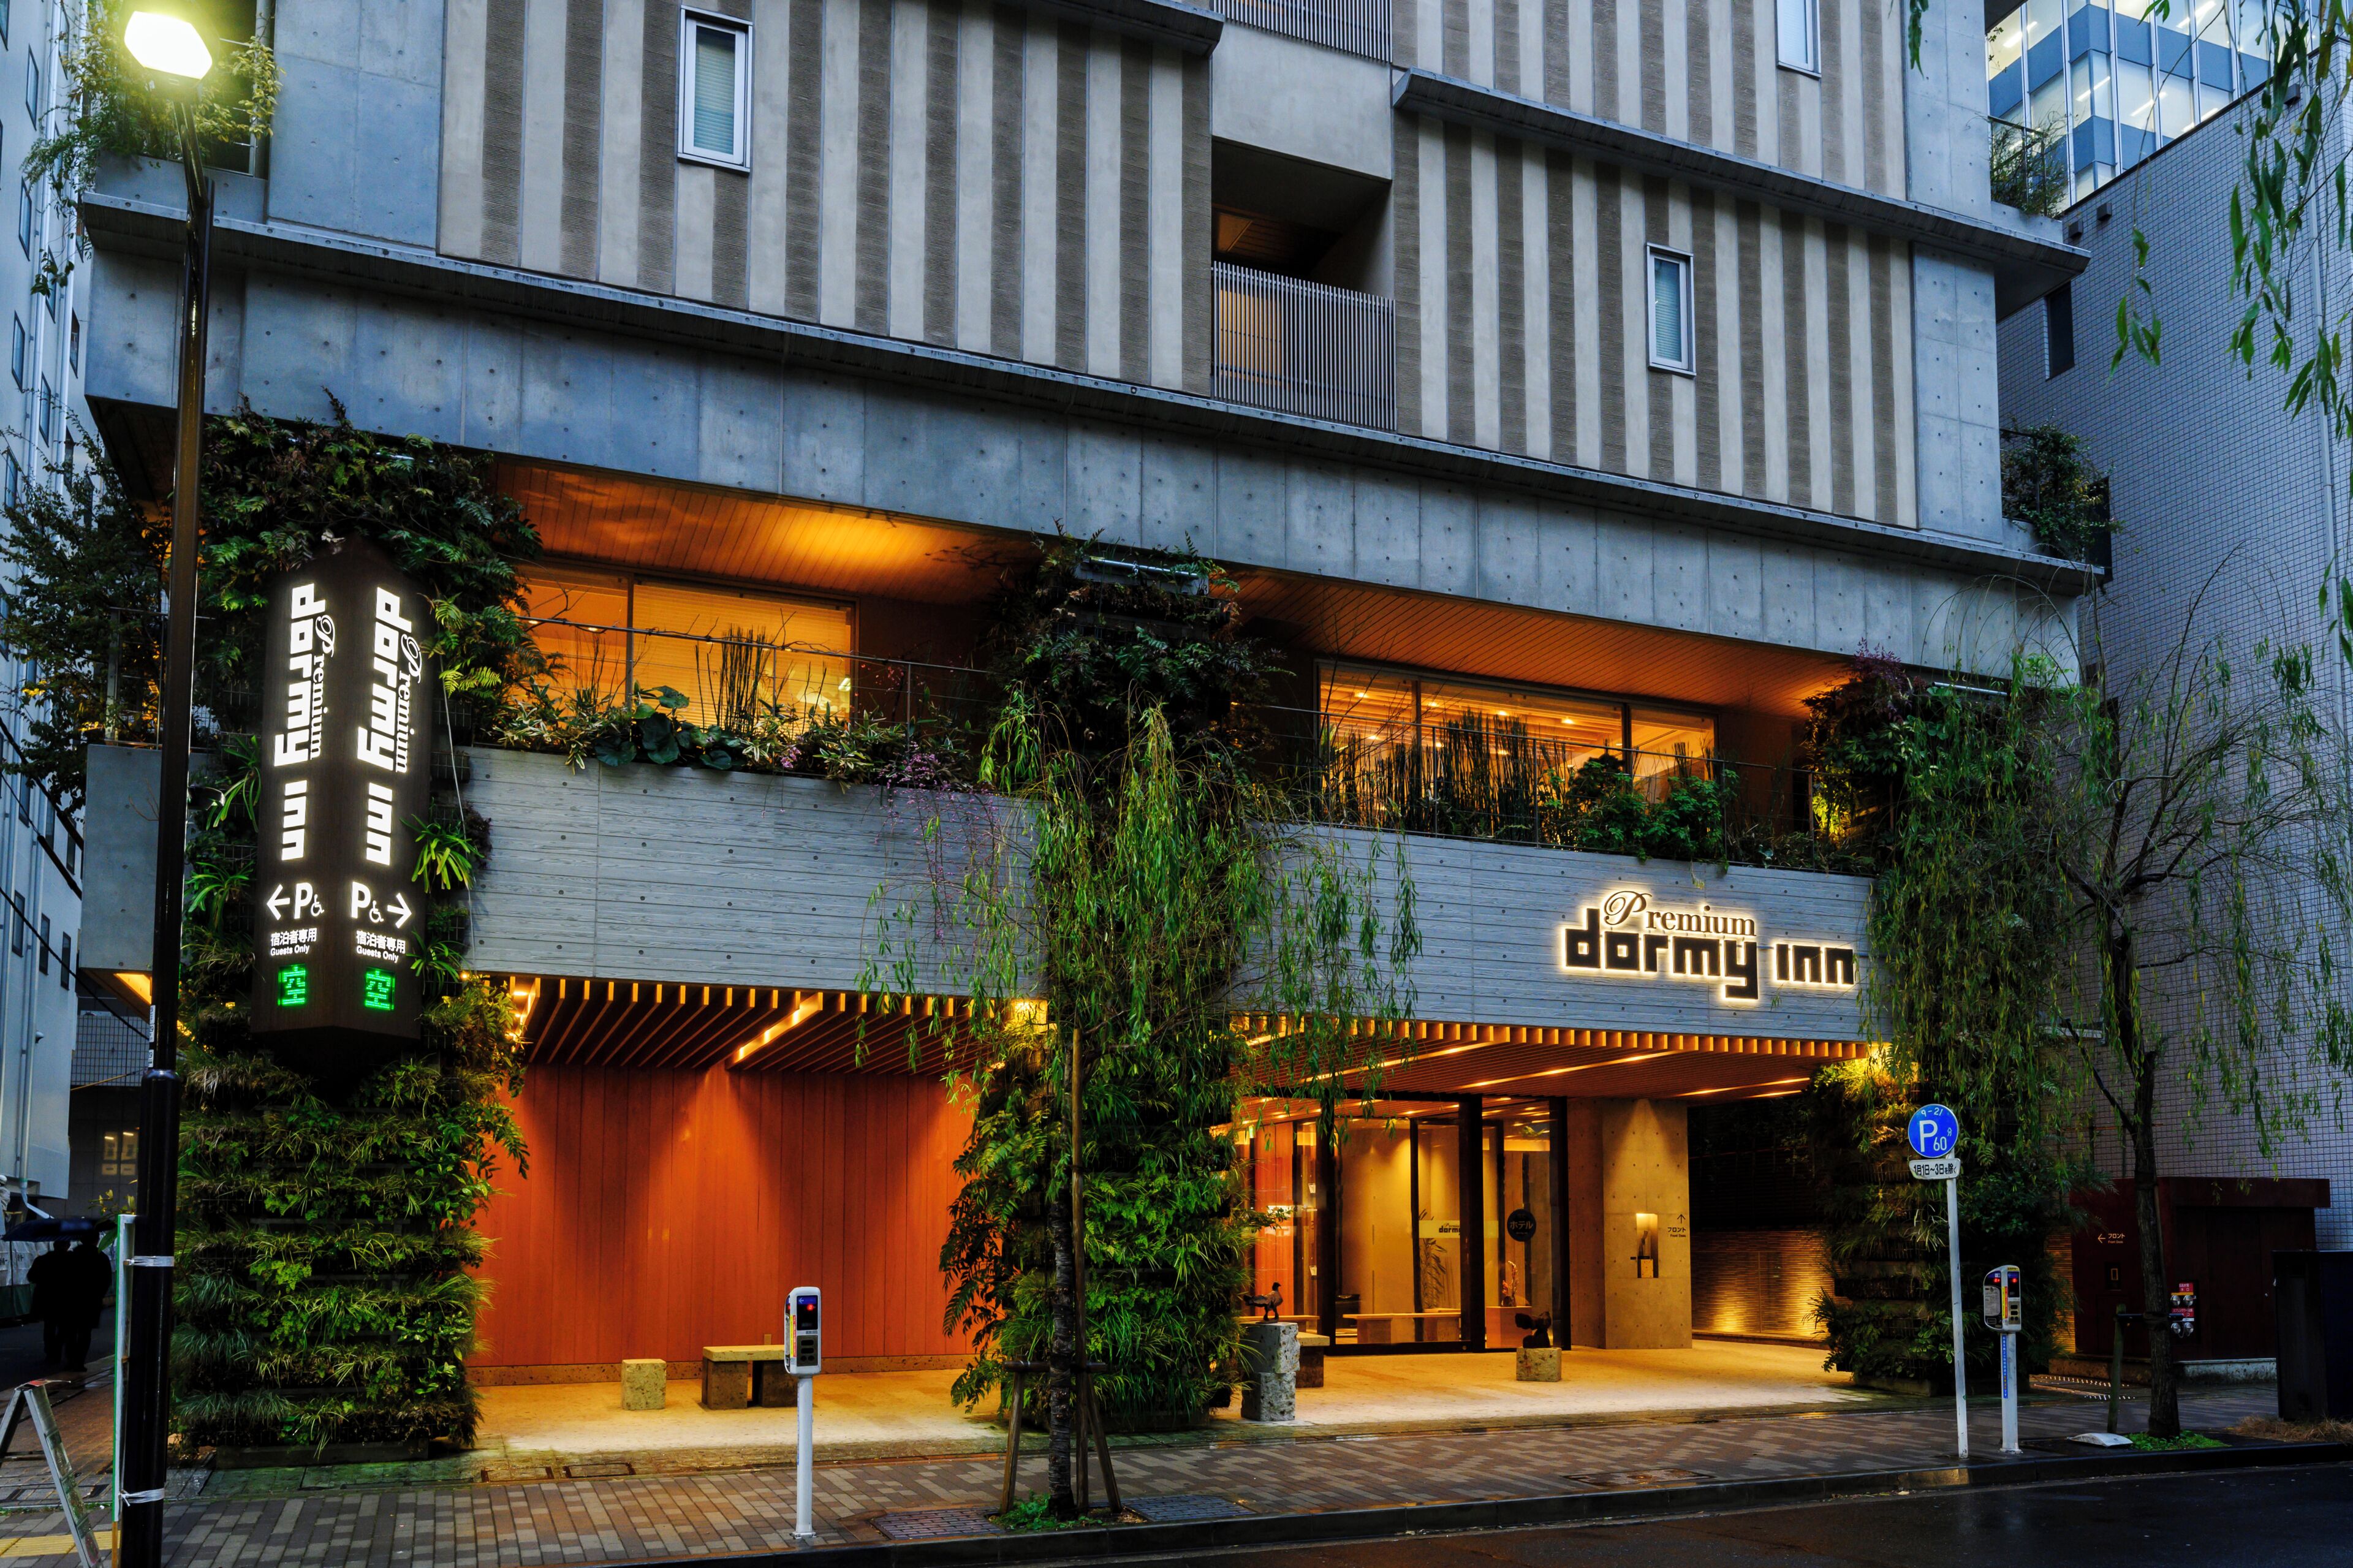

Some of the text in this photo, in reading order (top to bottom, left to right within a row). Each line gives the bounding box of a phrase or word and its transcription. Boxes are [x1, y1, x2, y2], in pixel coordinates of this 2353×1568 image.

[309, 615, 335, 760] Premium
[395, 634, 422, 773] Premium
[275, 583, 325, 860] dormy inn
[357, 587, 412, 865] dormy inn
[294, 882, 313, 919] P
[351, 882, 371, 918] P
[1604, 891, 1756, 936] Premium
[271, 928, 317, 946] 宿泊者専用
[271, 944, 309, 956] Guests Only
[357, 930, 406, 954] 宿泊者専用
[357, 945, 399, 963] Guests Only
[1565, 908, 1854, 999] dormy inn
[282, 966, 306, 1006] 空
[365, 971, 391, 1010] 空
[1921, 1107, 1943, 1117] 9-21
[1919, 1119, 1938, 1152] P
[1510, 1221, 1533, 1230] ホテル
